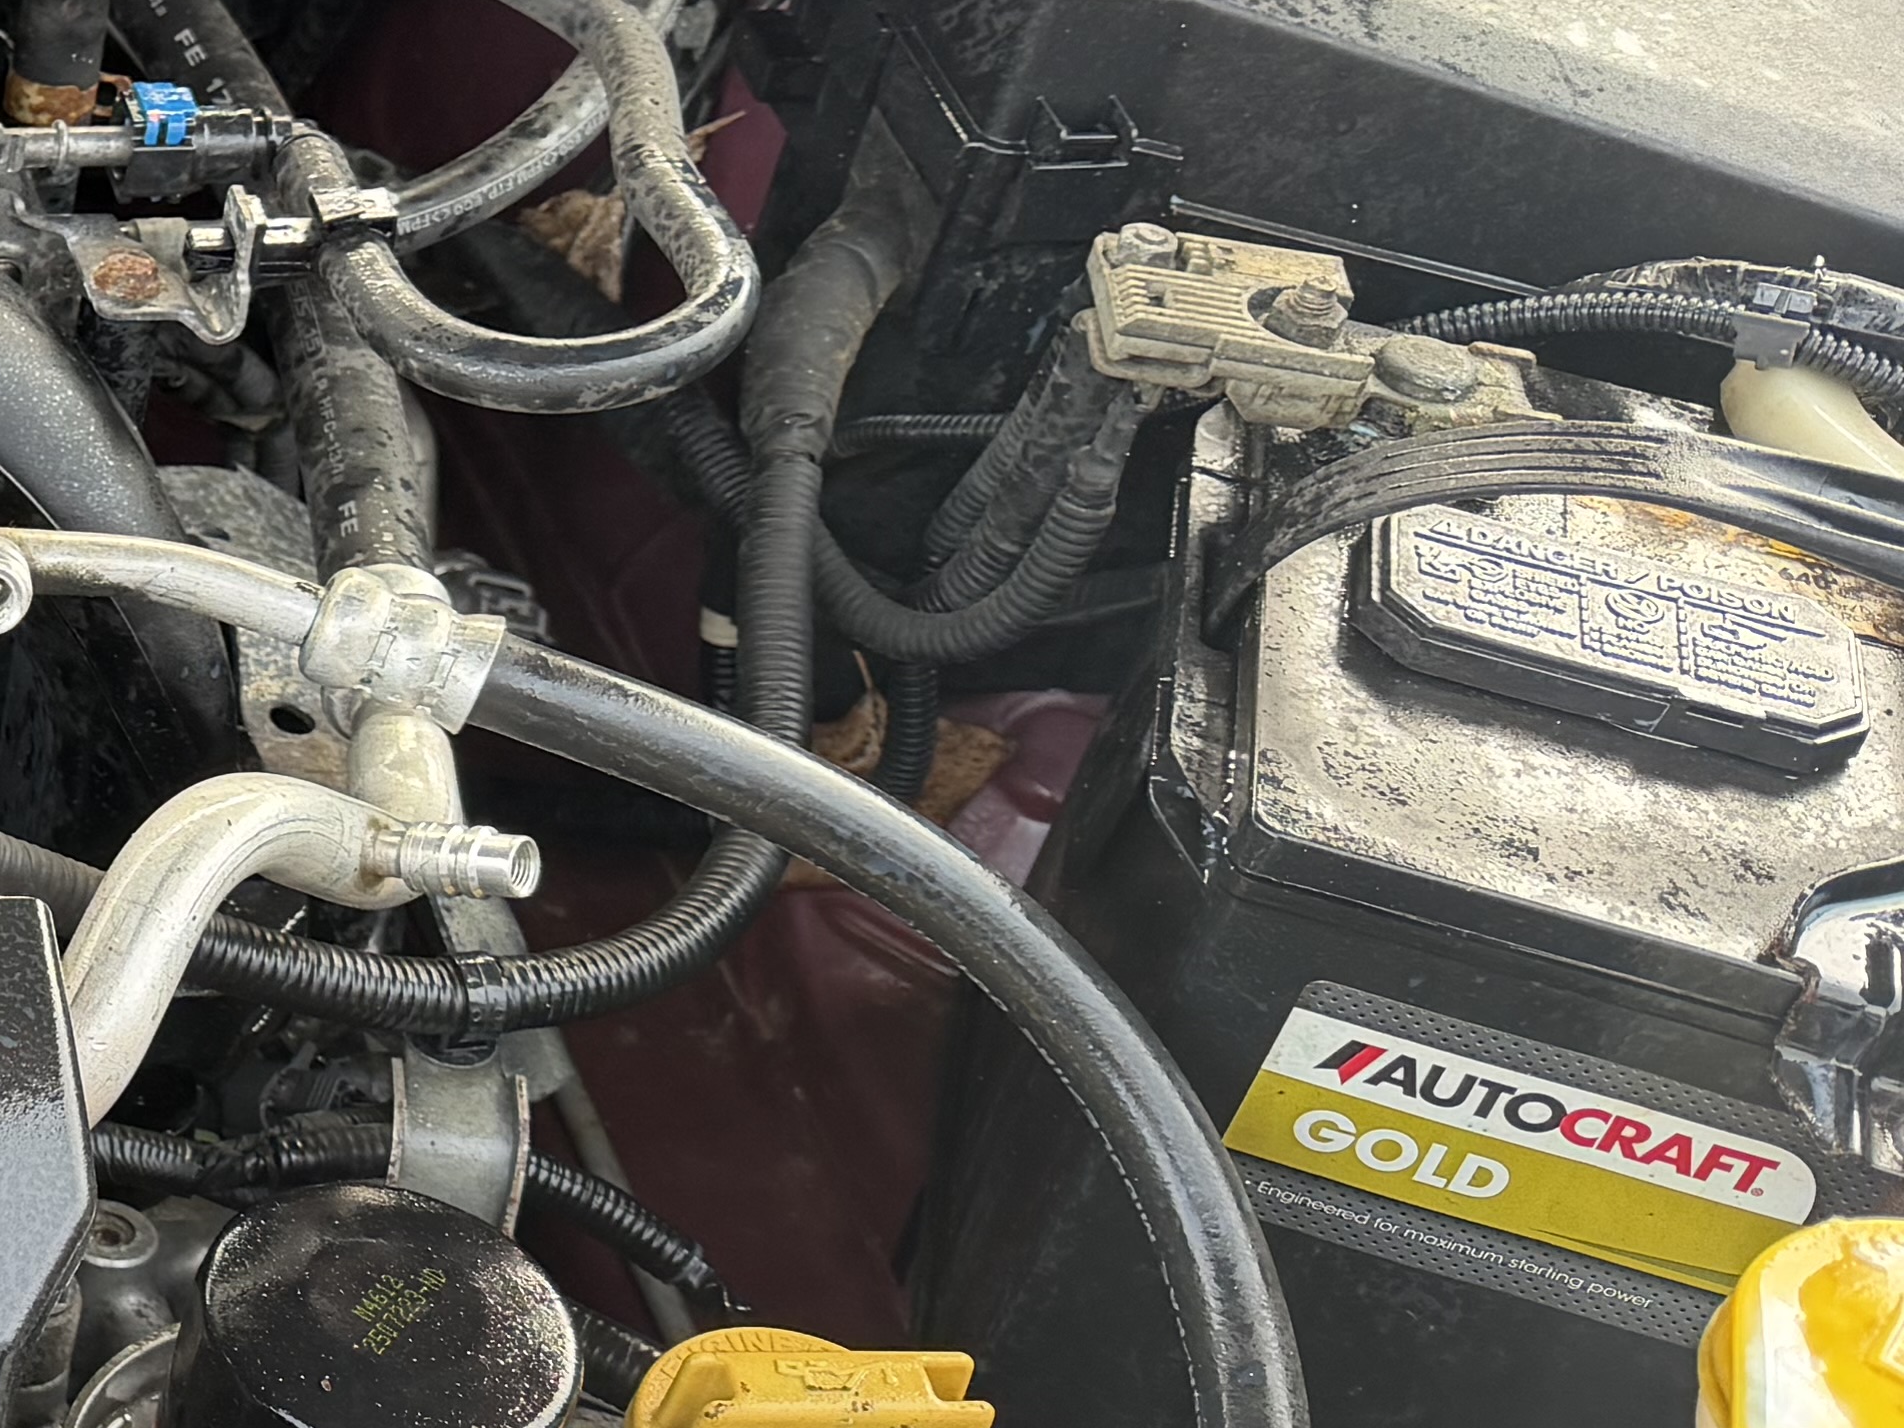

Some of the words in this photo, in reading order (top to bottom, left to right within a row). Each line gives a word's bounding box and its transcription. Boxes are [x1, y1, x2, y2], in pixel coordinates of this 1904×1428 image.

[173, 28, 208, 67] FE
[205, 77, 234, 105] 17
[337, 499, 360, 538] FE
[1466, 527, 1619, 581] DANGER
[1657, 573, 1799, 624] POISON
[1292, 1109, 1511, 1198] GOLD
[1363, 1053, 1781, 1194] AUTOCRAFT
[1256, 1181, 1371, 1225] Engineered
[1373, 1216, 1401, 1236] for
[1403, 1229, 1504, 1265] maximum
[1507, 1254, 1584, 1291] starting
[1589, 1280, 1654, 1310] power
